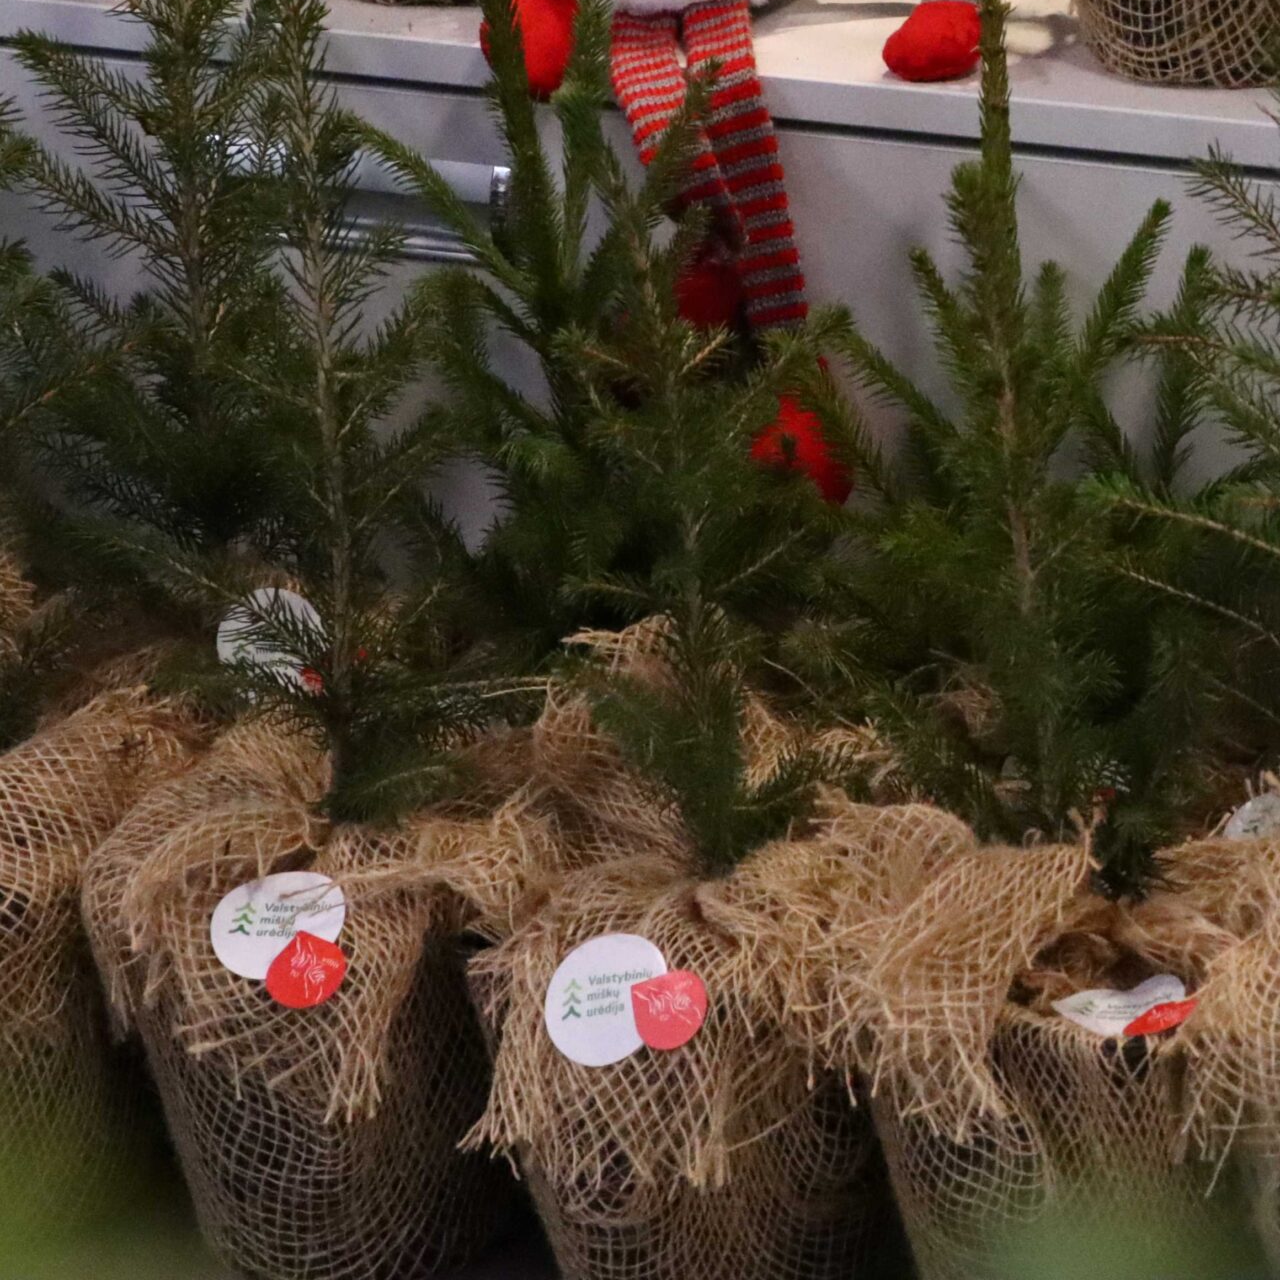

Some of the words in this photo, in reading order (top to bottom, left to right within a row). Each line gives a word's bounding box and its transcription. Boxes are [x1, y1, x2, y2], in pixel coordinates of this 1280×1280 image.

[265, 901, 333, 914] Valstinių
[588, 967, 653, 987] Valstybinių
[586, 986, 620, 1001] miškų
[586, 1000, 625, 1017] urėdija
